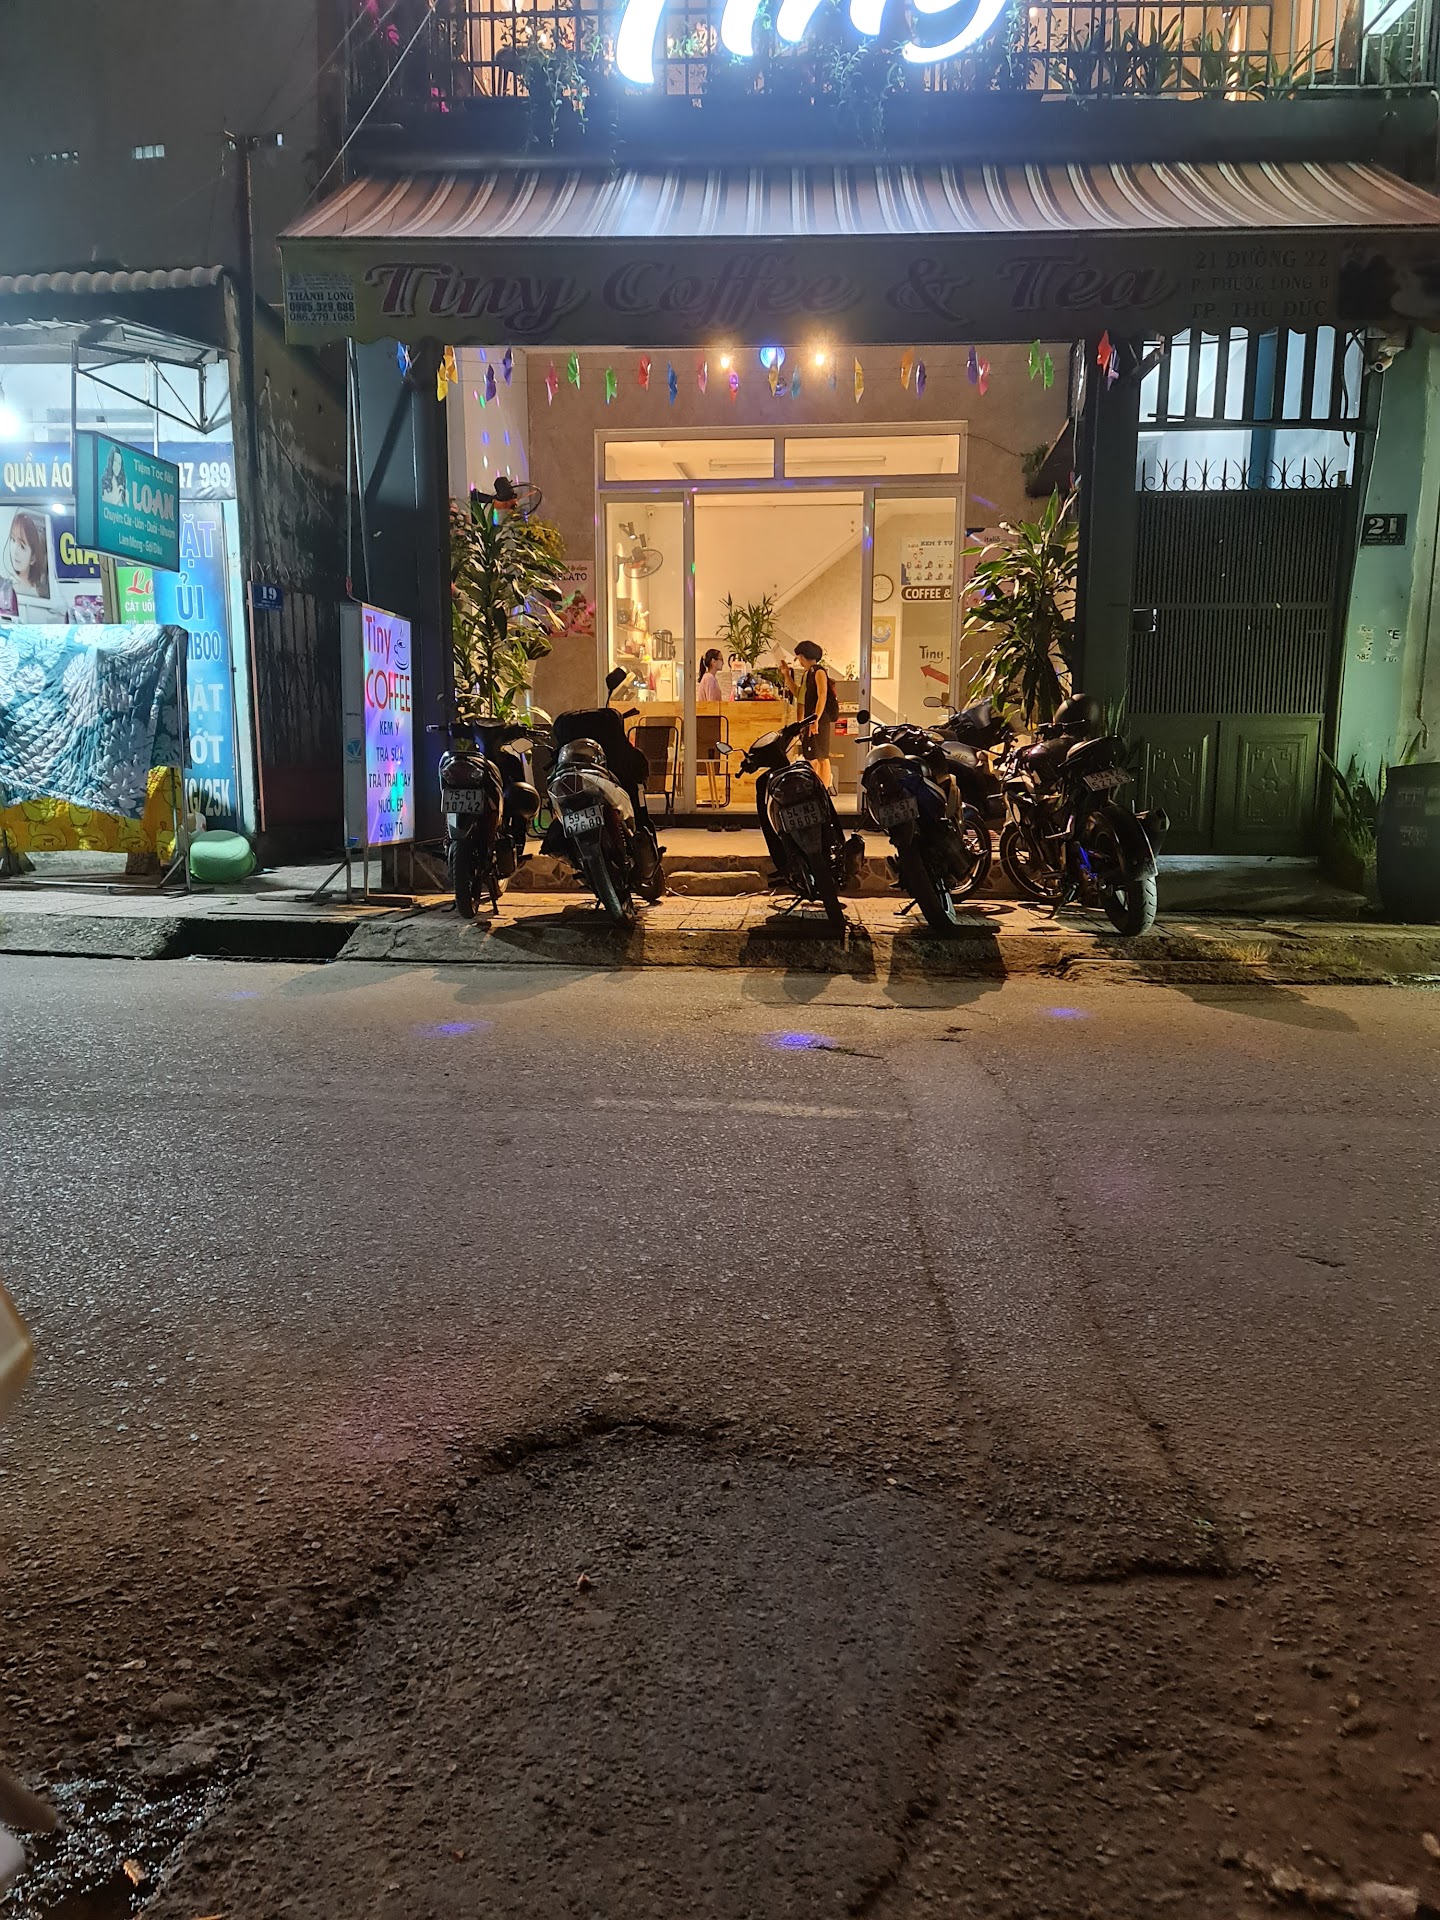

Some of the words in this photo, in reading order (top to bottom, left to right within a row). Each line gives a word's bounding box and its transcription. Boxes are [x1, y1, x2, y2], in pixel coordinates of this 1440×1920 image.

[327, 291, 354, 301] LONG
[363, 261, 591, 335] Tiny
[602, 251, 865, 331] Coffee
[994, 257, 1178, 313] Tea
[4, 452, 47, 492] QUẦN
[199, 461, 231, 488] 989
[1367, 517, 1397, 534] 21
[180, 513, 216, 568] ẶT
[175, 571, 205, 621] ỦI
[262, 586, 278, 601] 19
[905, 588, 941, 599] COFFEE
[365, 614, 391, 664] Tiny
[919, 645, 944, 663] Tiny
[188, 677, 224, 720] ẶT
[366, 669, 411, 713] COFFEE
[379, 720, 393, 736] KEM
[189, 728, 224, 764] ỚT
[449, 790, 476, 801] 75-C1
[445, 801, 480, 812] 107.42
[568, 807, 596, 824] 59-L3
